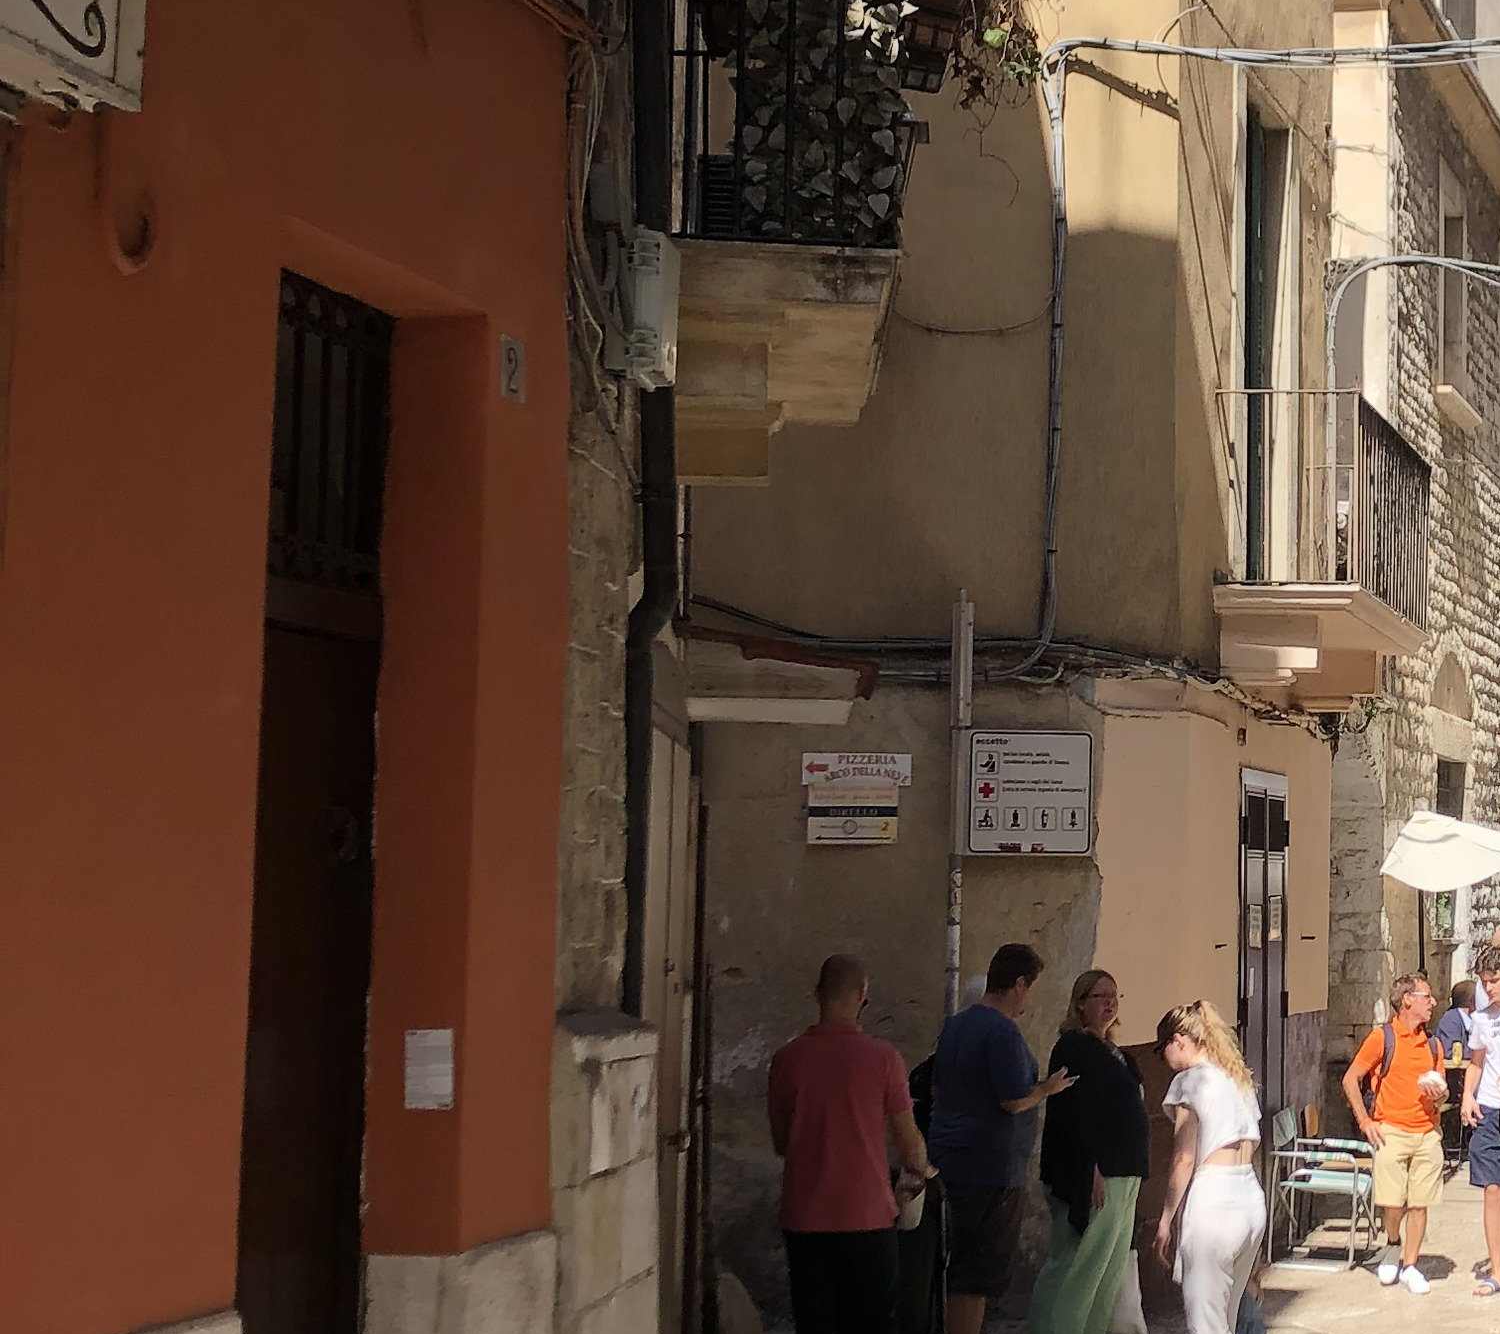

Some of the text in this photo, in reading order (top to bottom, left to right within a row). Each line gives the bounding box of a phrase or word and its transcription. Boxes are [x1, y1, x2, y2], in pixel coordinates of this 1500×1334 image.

[837, 754, 897, 764] PIZZERIA
[824, 767, 910, 783] ARCO DELLA NEVE
